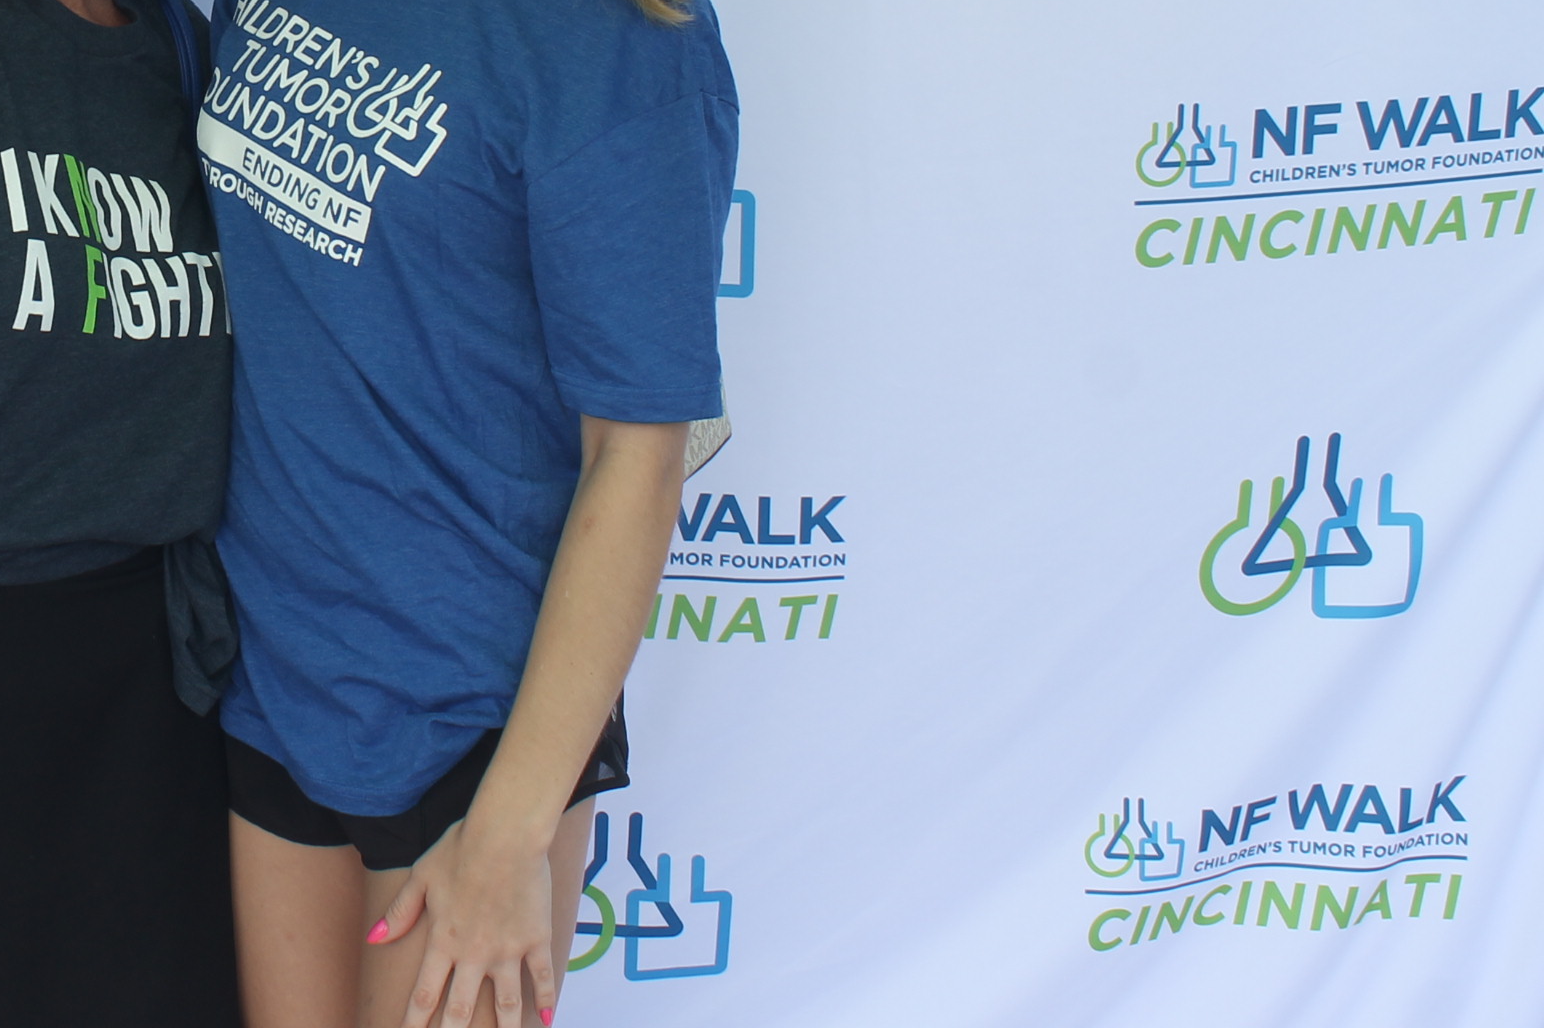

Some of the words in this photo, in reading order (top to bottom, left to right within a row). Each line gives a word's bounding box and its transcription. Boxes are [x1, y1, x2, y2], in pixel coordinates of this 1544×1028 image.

[232, 39, 352, 128] TUMOR
[1252, 103, 1342, 159] NF
[1356, 86, 1544, 151] WALK
[204, 67, 386, 202] OUNDATION
[1249, 162, 1357, 184] CHILDREN'S
[1363, 157, 1425, 176] TUMOR
[1431, 146, 1544, 170] FOUNDATION
[0, 147, 29, 233] I
[27, 150, 174, 253] KNOW
[201, 157, 264, 214] TROUGH
[264, 201, 363, 266] RESEARCH
[242, 146, 322, 209] ENDING
[322, 197, 363, 229] NF
[1135, 187, 1536, 268] CINCINNATI
[12, 238, 55, 332] A
[82, 244, 232, 341] FIGHT
[669, 552, 713, 567] MOR
[720, 553, 846, 570] FOUNDATION
[1194, 841, 1282, 873] CHILDREN'S
[1288, 840, 1355, 858] TUMOR
[1362, 833, 1468, 858] FOUNDATION
[1198, 795, 1277, 853] NF
[1288, 775, 1467, 835] WALK
[1087, 872, 1462, 952] CINCINNATI
